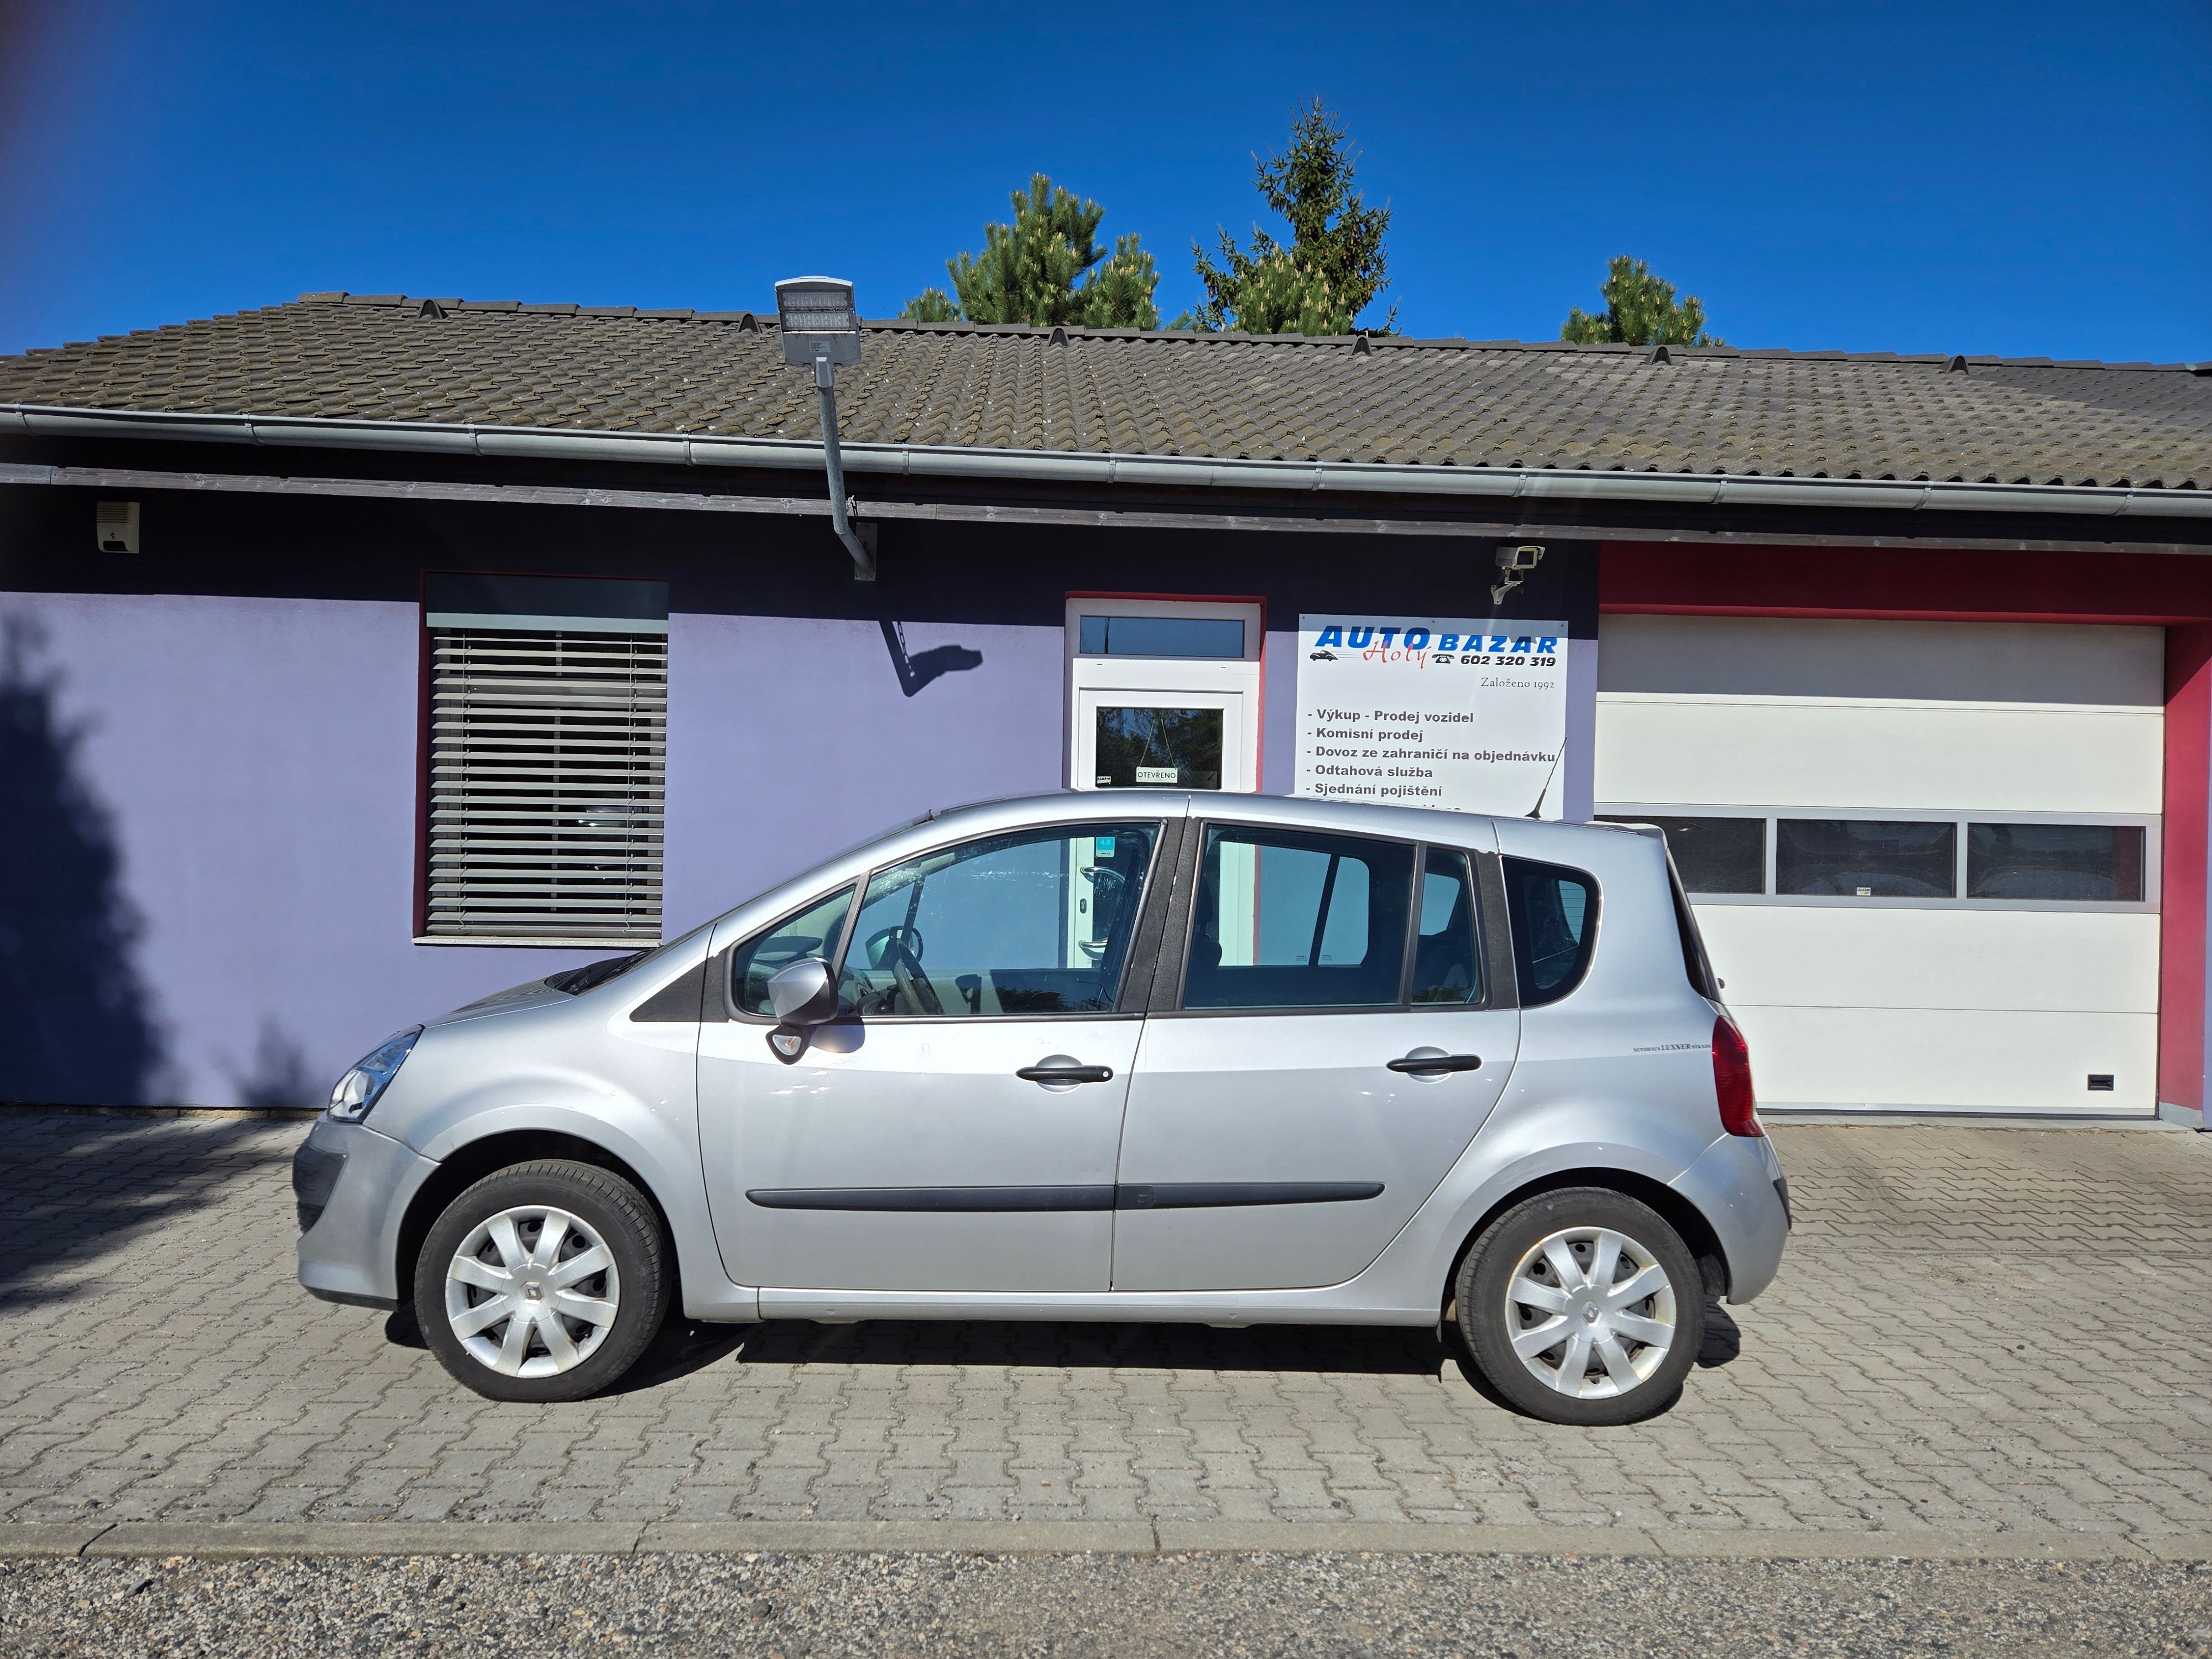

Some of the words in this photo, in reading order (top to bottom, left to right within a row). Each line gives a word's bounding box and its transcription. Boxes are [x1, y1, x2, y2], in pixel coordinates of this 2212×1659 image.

[1314, 625, 1431, 650] AUTO
[1438, 634, 1558, 654] BAZAR
[1363, 640, 1432, 669] Holý
[1460, 655, 1491, 665] 602
[1495, 656, 1525, 666] 320
[1530, 657, 1556, 666] 319
[1481, 677, 1530, 687] Založeno
[1534, 681, 1554, 690] 1992
[1317, 709, 1360, 722] Výkup
[1374, 711, 1420, 724] Prodej
[1425, 712, 1474, 723] vozidel
[1317, 728, 1374, 739] Komisní
[1378, 730, 1423, 742] prodej
[1316, 746, 1358, 757] Dovoz
[1383, 748, 1448, 759] zahraničí
[1453, 752, 1469, 760] na
[1474, 750, 1555, 763] objednávku
[1138, 770, 1176, 779] OTEVŘENO
[1316, 765, 1383, 776] Odtahová
[1387, 767, 1432, 778] služba
[1315, 783, 1376, 796] Sjednání
[1381, 785, 1442, 797] pojištění
